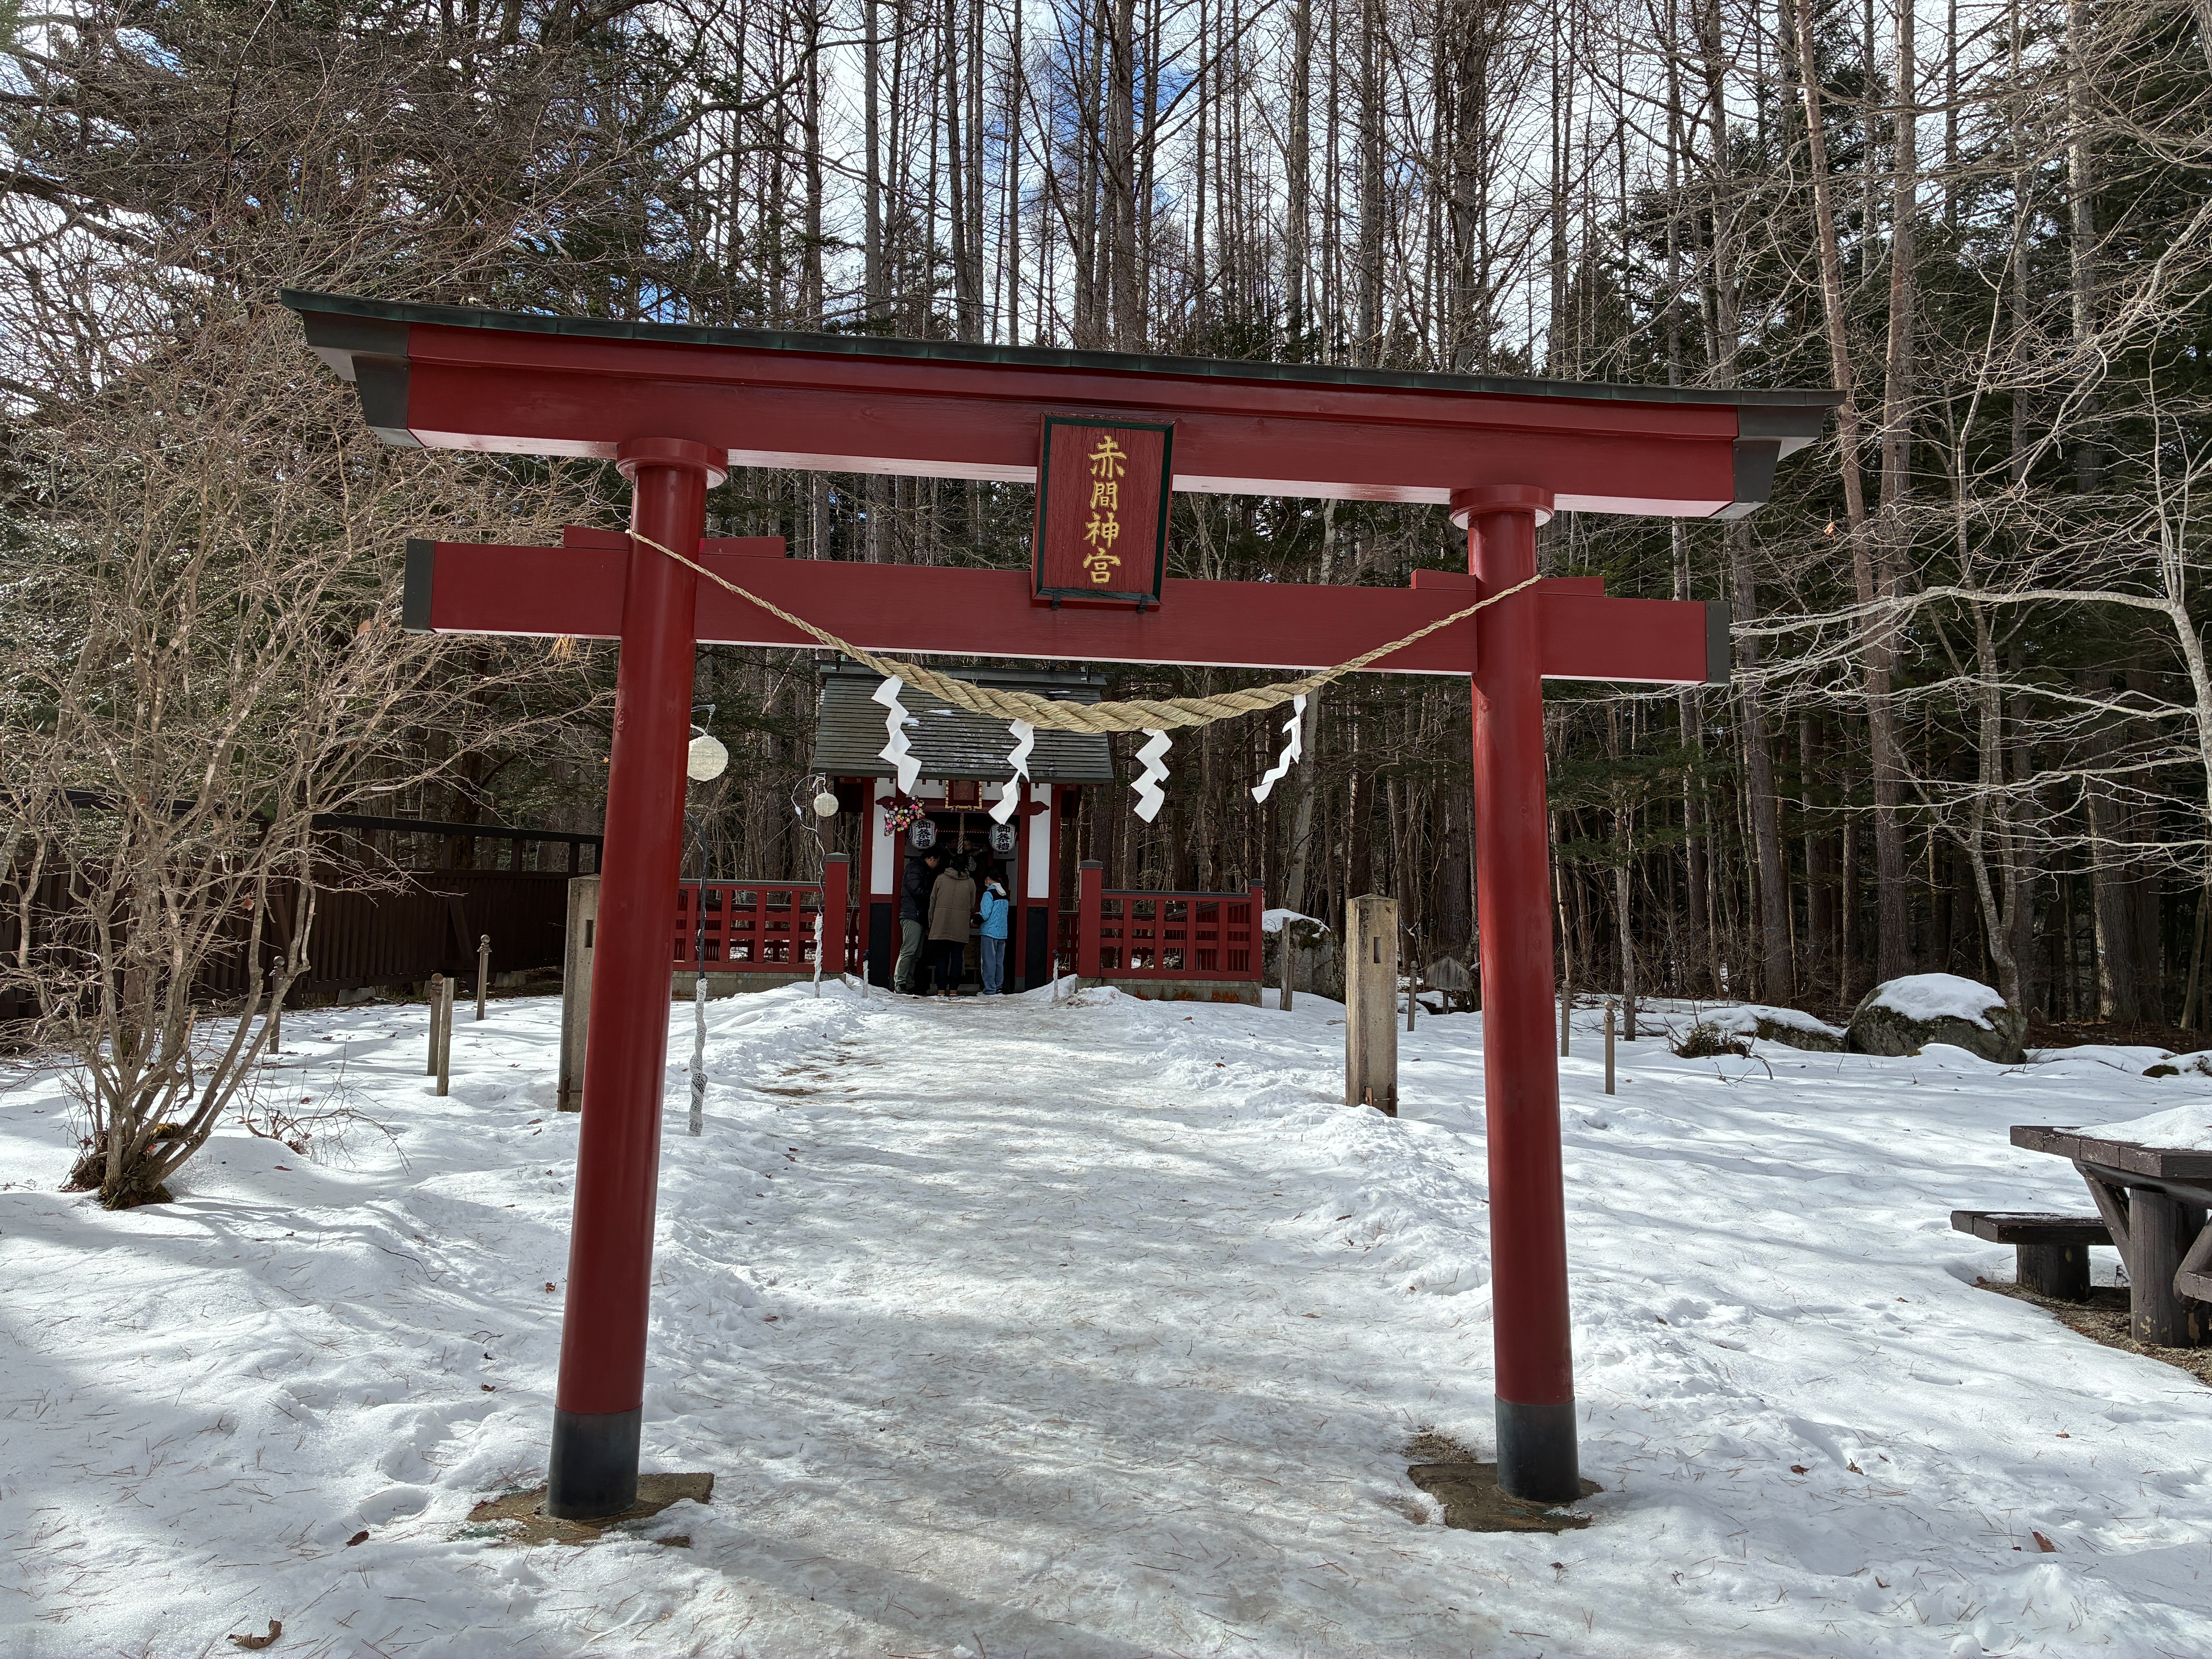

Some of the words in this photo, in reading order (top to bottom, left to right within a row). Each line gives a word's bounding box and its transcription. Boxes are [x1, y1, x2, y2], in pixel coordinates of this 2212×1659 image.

[1083, 434, 1127, 583] 赤間神宮
[915, 820, 931, 847] 御祭禮
[995, 824, 1010, 850] 御祭禮
